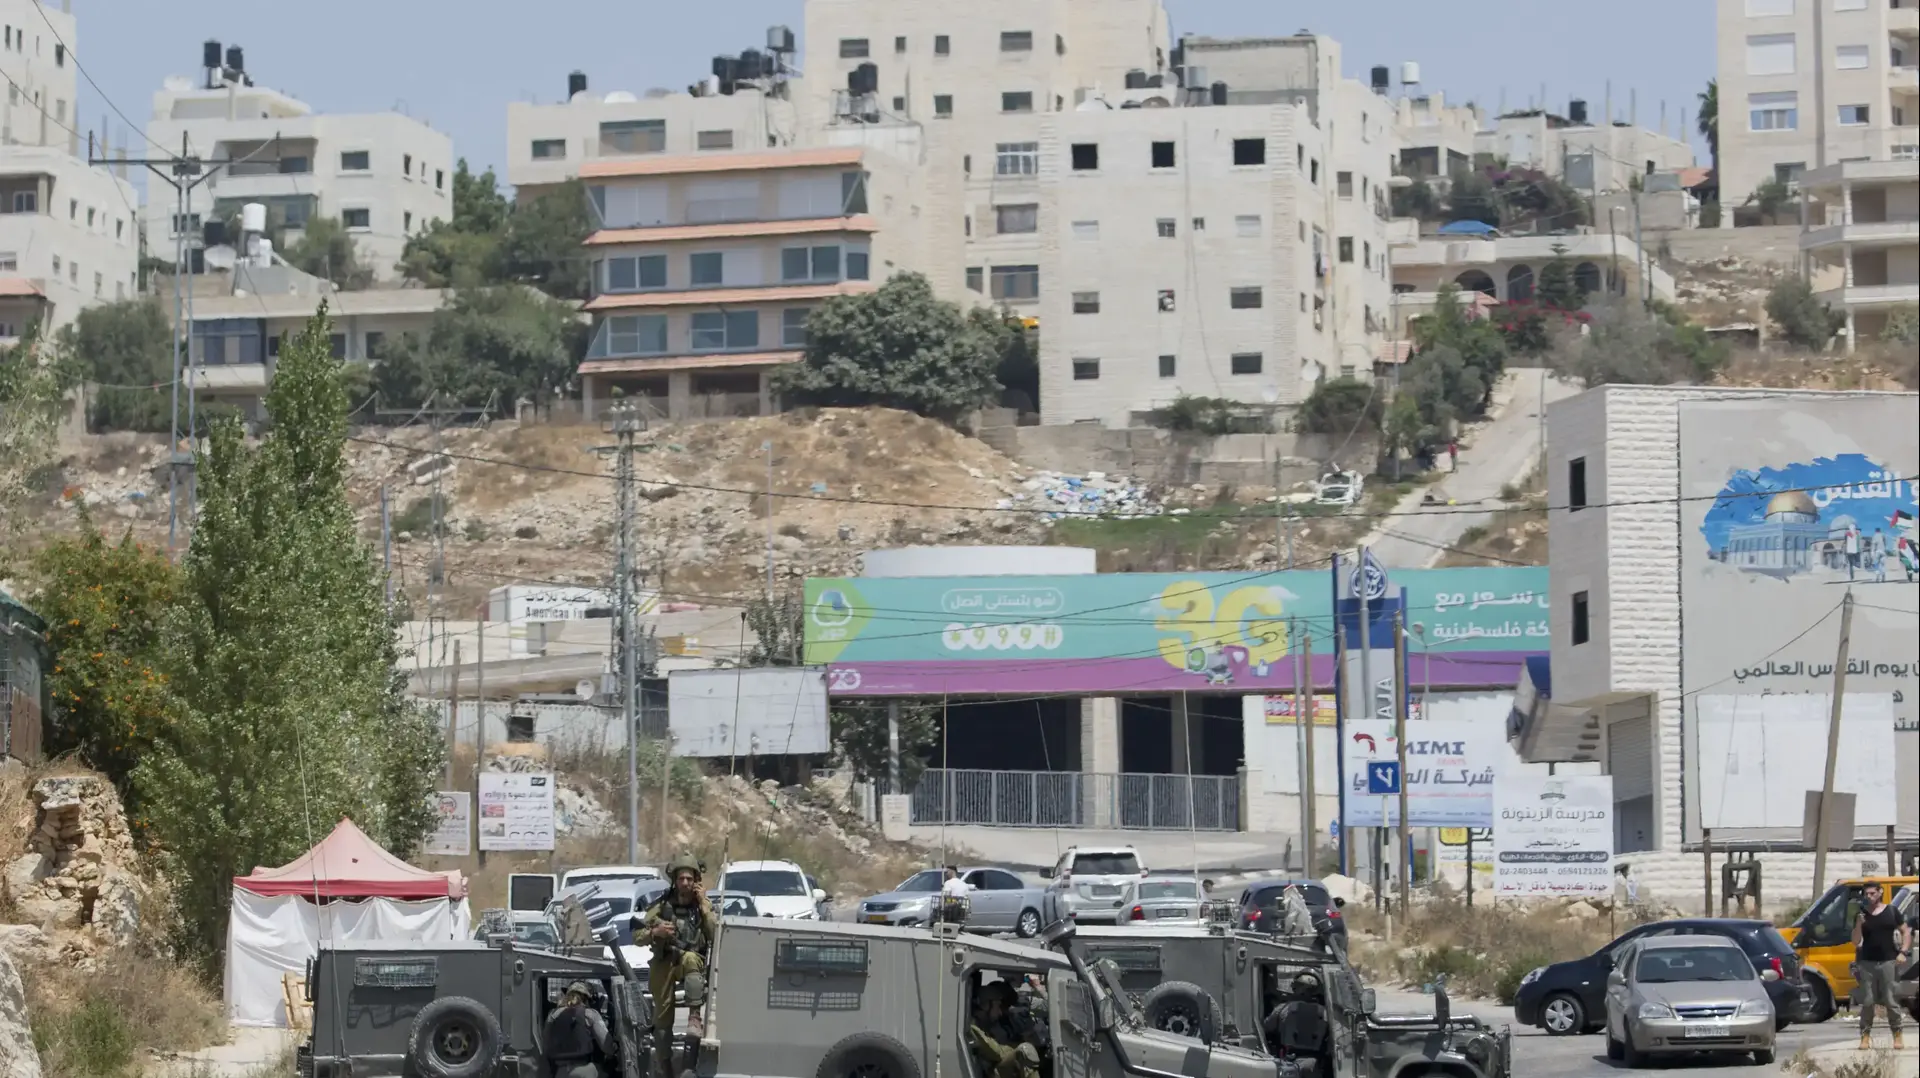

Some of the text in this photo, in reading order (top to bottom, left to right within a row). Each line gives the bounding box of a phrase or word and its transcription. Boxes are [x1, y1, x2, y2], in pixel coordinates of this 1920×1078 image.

[1813, 471, 1902, 508] القدس
[1434, 592, 1466, 613] مع
[1154, 580, 1288, 671] 3G
[1433, 620, 1522, 639] فلسطينية
[1733, 661, 1804, 684] العالمي
[1808, 658, 1870, 678] القس
[1873, 662, 1909, 678] يوم
[1501, 806, 1554, 822] الزيتونة
[1556, 808, 1606, 823] مدرسة
